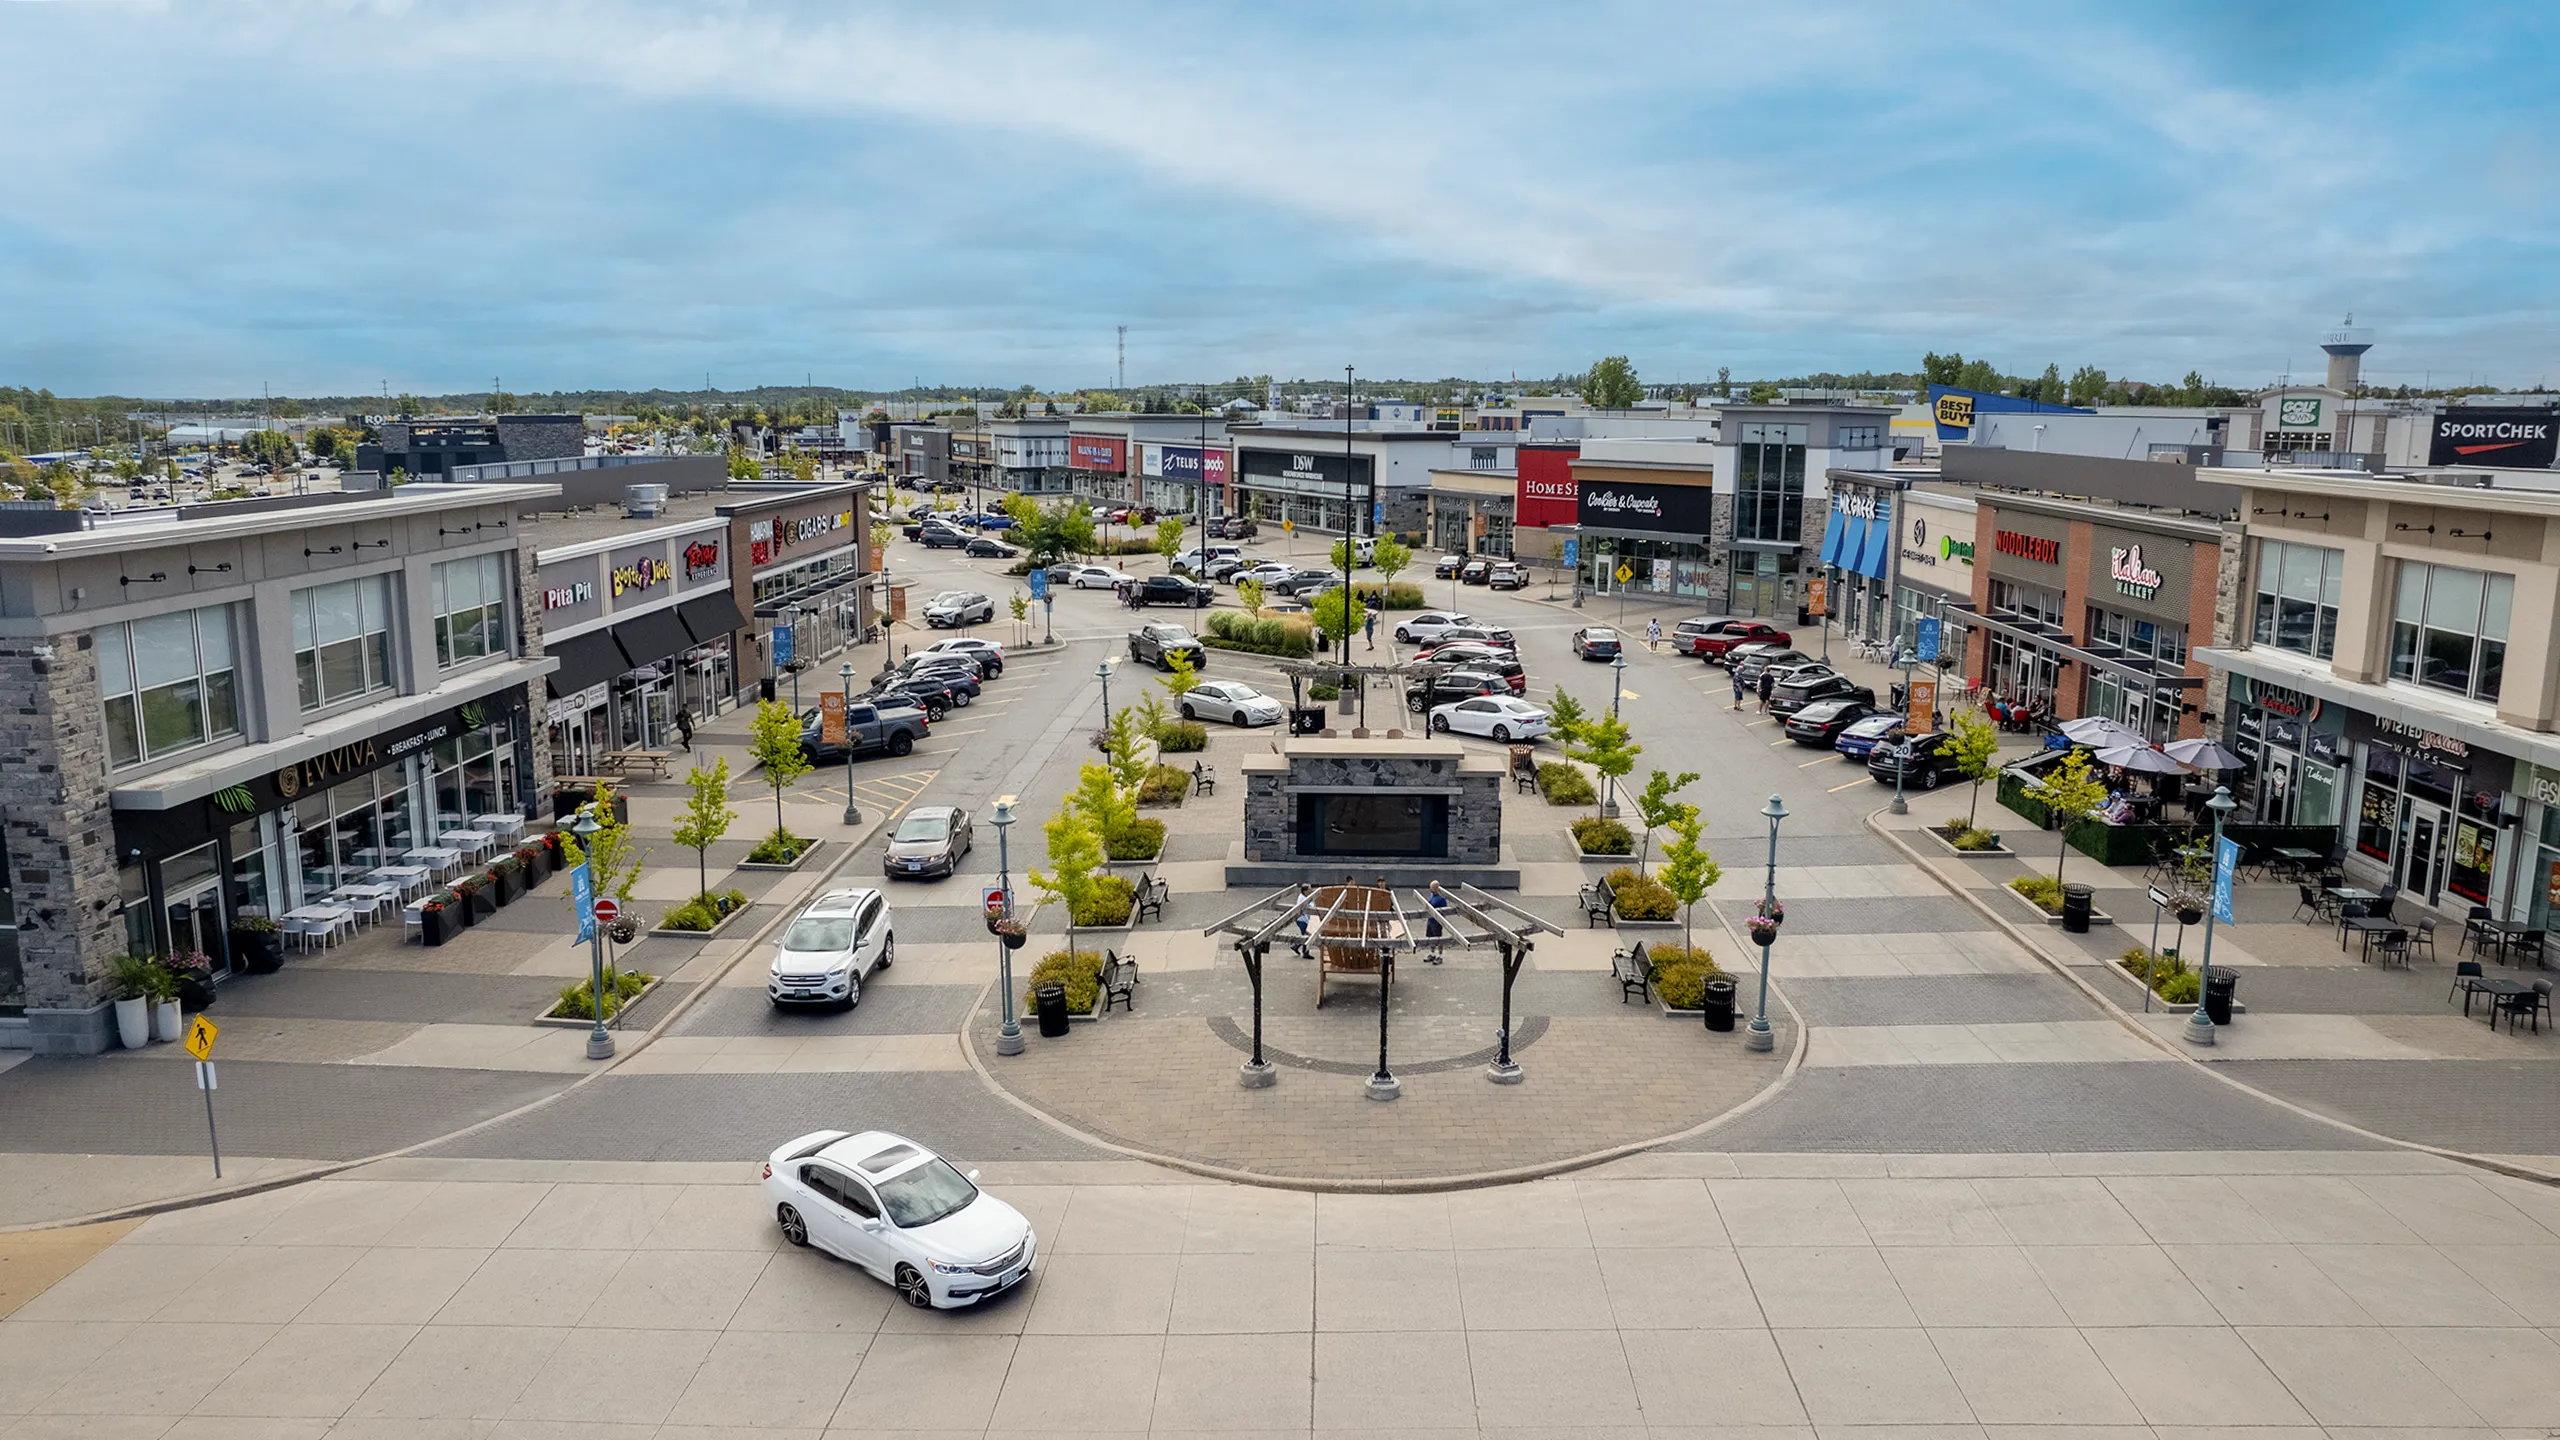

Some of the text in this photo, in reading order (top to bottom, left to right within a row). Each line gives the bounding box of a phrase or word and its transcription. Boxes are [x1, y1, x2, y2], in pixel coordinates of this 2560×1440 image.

[1941, 400, 1970, 412] BEST
[2283, 401, 2317, 412] GOLF
[1940, 410, 1966, 422] BUY
[2286, 413, 2311, 421] TOWN
[1176, 456, 1199, 469] TELUS
[1293, 455, 1314, 471] DSW
[1588, 491, 1658, 510] Cookies & Cupcake
[799, 515, 827, 541] CIGARS
[1996, 530, 2058, 564] NOODLEBOX
[548, 582, 593, 609] Pita Pit
[2116, 582, 2153, 600] MARKET
[2261, 697, 2300, 717] EATERY
[2375, 715, 2422, 739] TWISTED
[391, 725, 447, 755] BREAKFAST LUNCH
[1895, 746, 1909, 755] 20
[2393, 743, 2438, 765] WRAPS
[305, 739, 378, 787] EVVIVA
